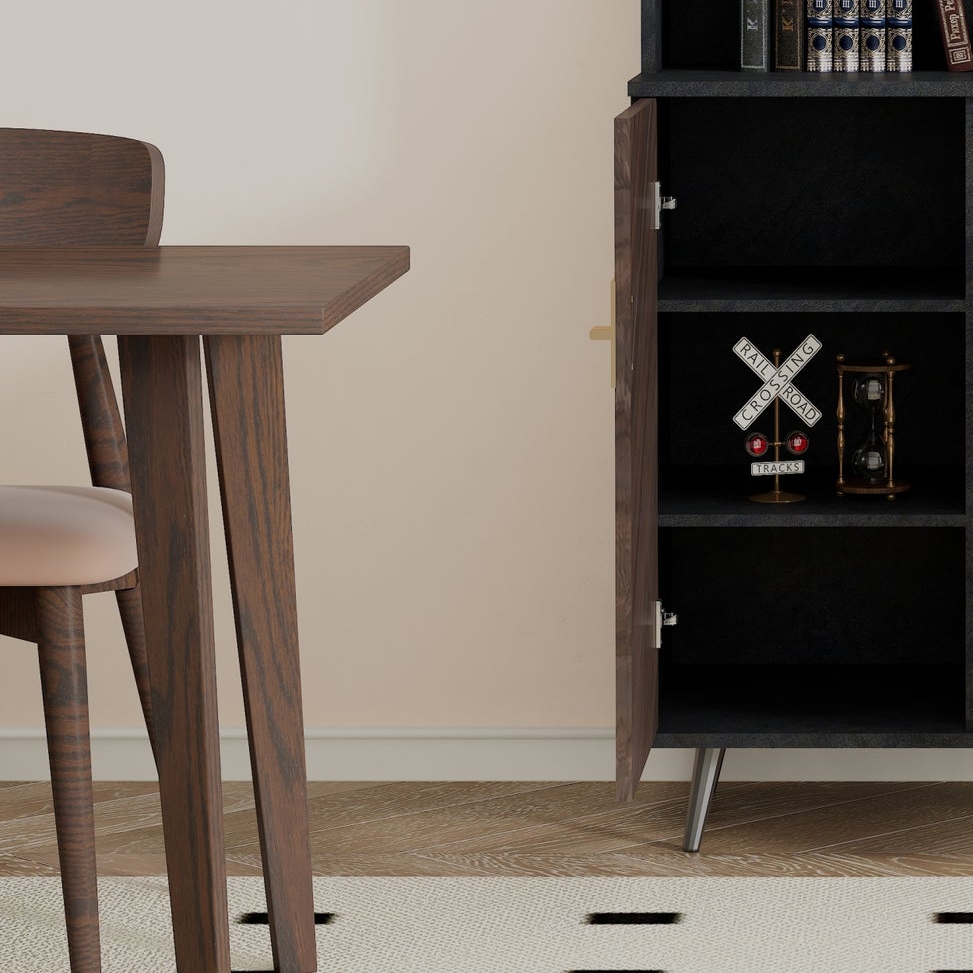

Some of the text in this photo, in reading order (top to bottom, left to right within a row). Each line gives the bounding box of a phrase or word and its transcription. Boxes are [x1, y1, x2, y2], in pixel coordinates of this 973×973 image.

[740, 343, 817, 420] RAIL ROAD
[741, 342, 814, 421] CROSSING
[757, 463, 800, 473] TRACKS
